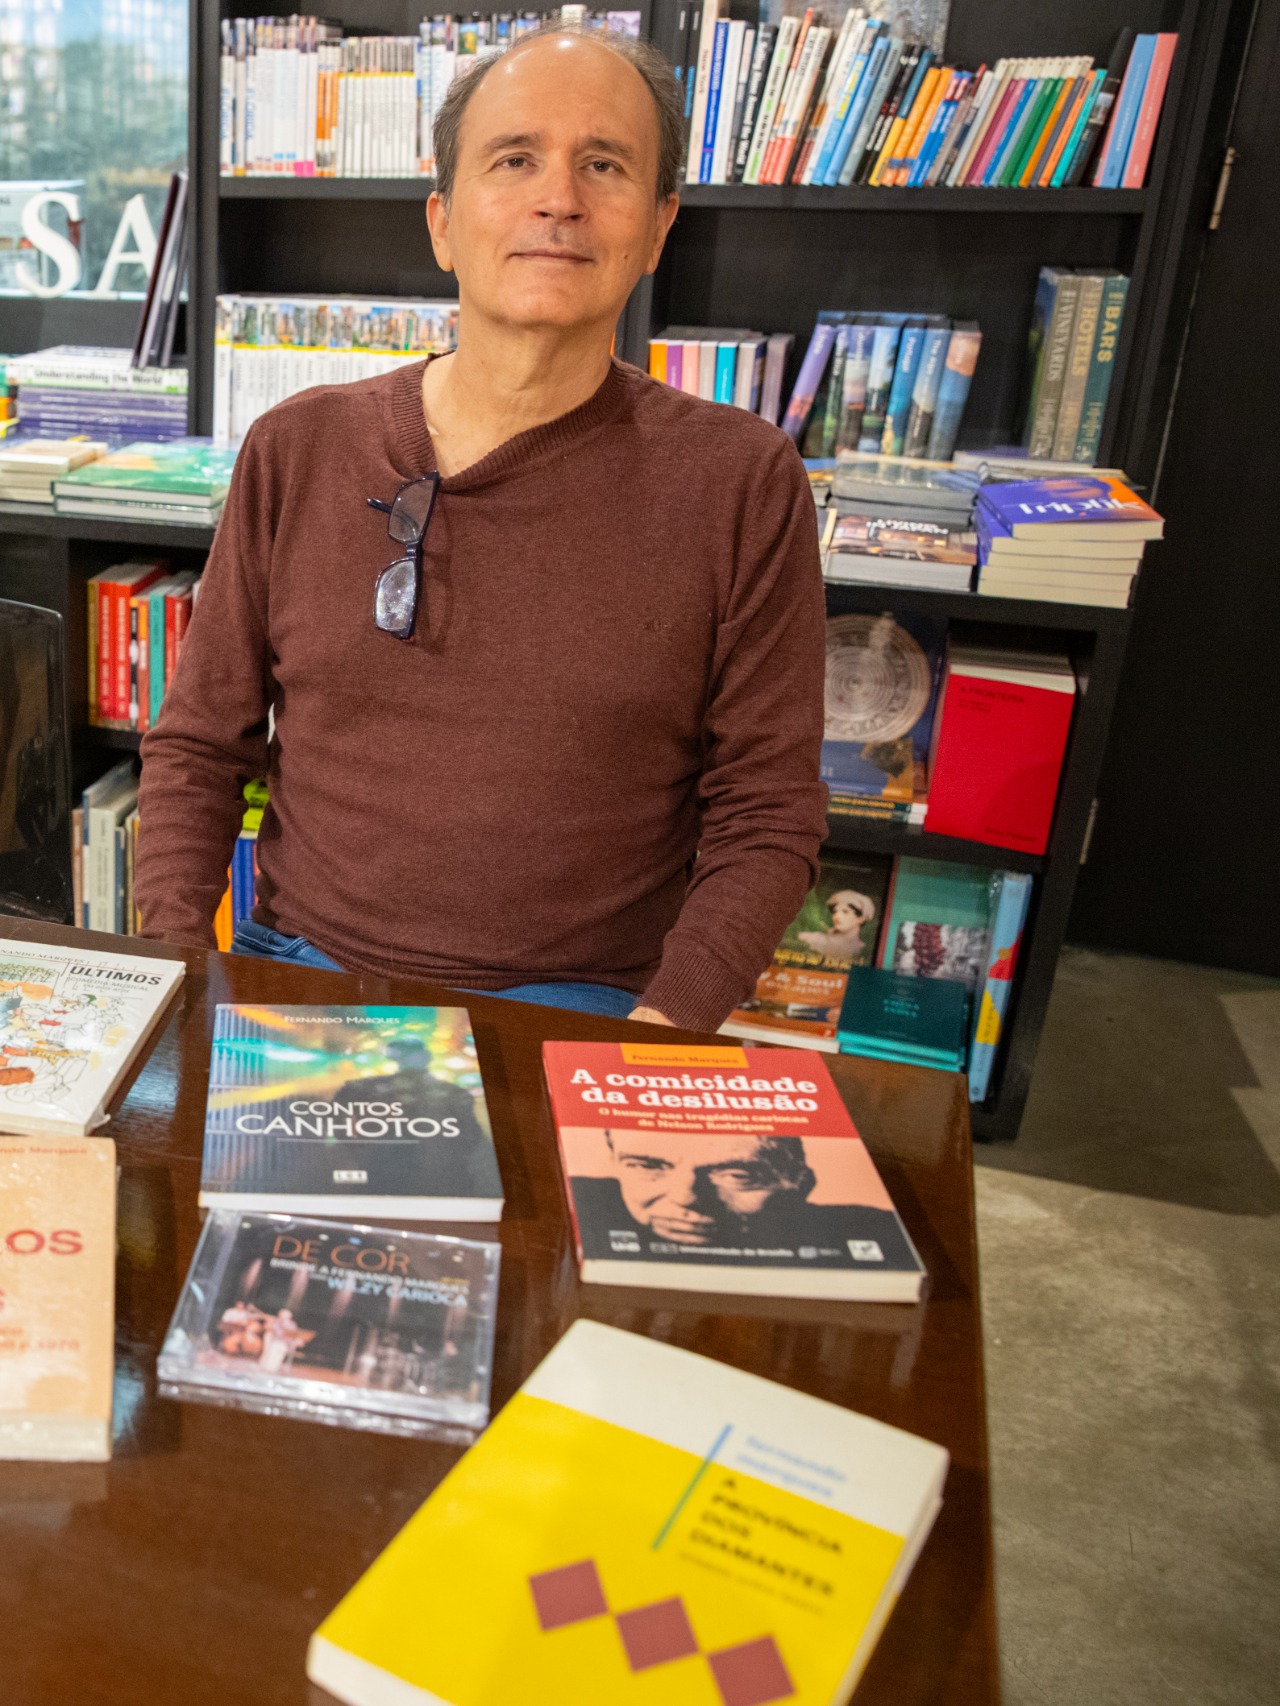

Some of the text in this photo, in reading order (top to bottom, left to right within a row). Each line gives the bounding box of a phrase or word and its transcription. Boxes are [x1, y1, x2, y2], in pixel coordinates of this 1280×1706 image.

[1072, 307, 1097, 376] HOTELS
[1097, 306, 1121, 363] BARS
[283, 1015, 400, 1025] FERNANDO MARQUES
[570, 1068, 818, 1093] A comicidade
[289, 1100, 404, 1117] CONTOS
[581, 1087, 818, 1112] da desilusão
[235, 1114, 461, 1138] CANHOTOS
[612, 1108, 657, 1119] humor
[660, 1112, 683, 1121] nas
[686, 1112, 750, 1124] tragédias
[751, 1115, 810, 1124] cariocas
[637, 1118, 775, 1132] de Nelson Rodrigues
[271, 1235, 411, 1275] DE COR
